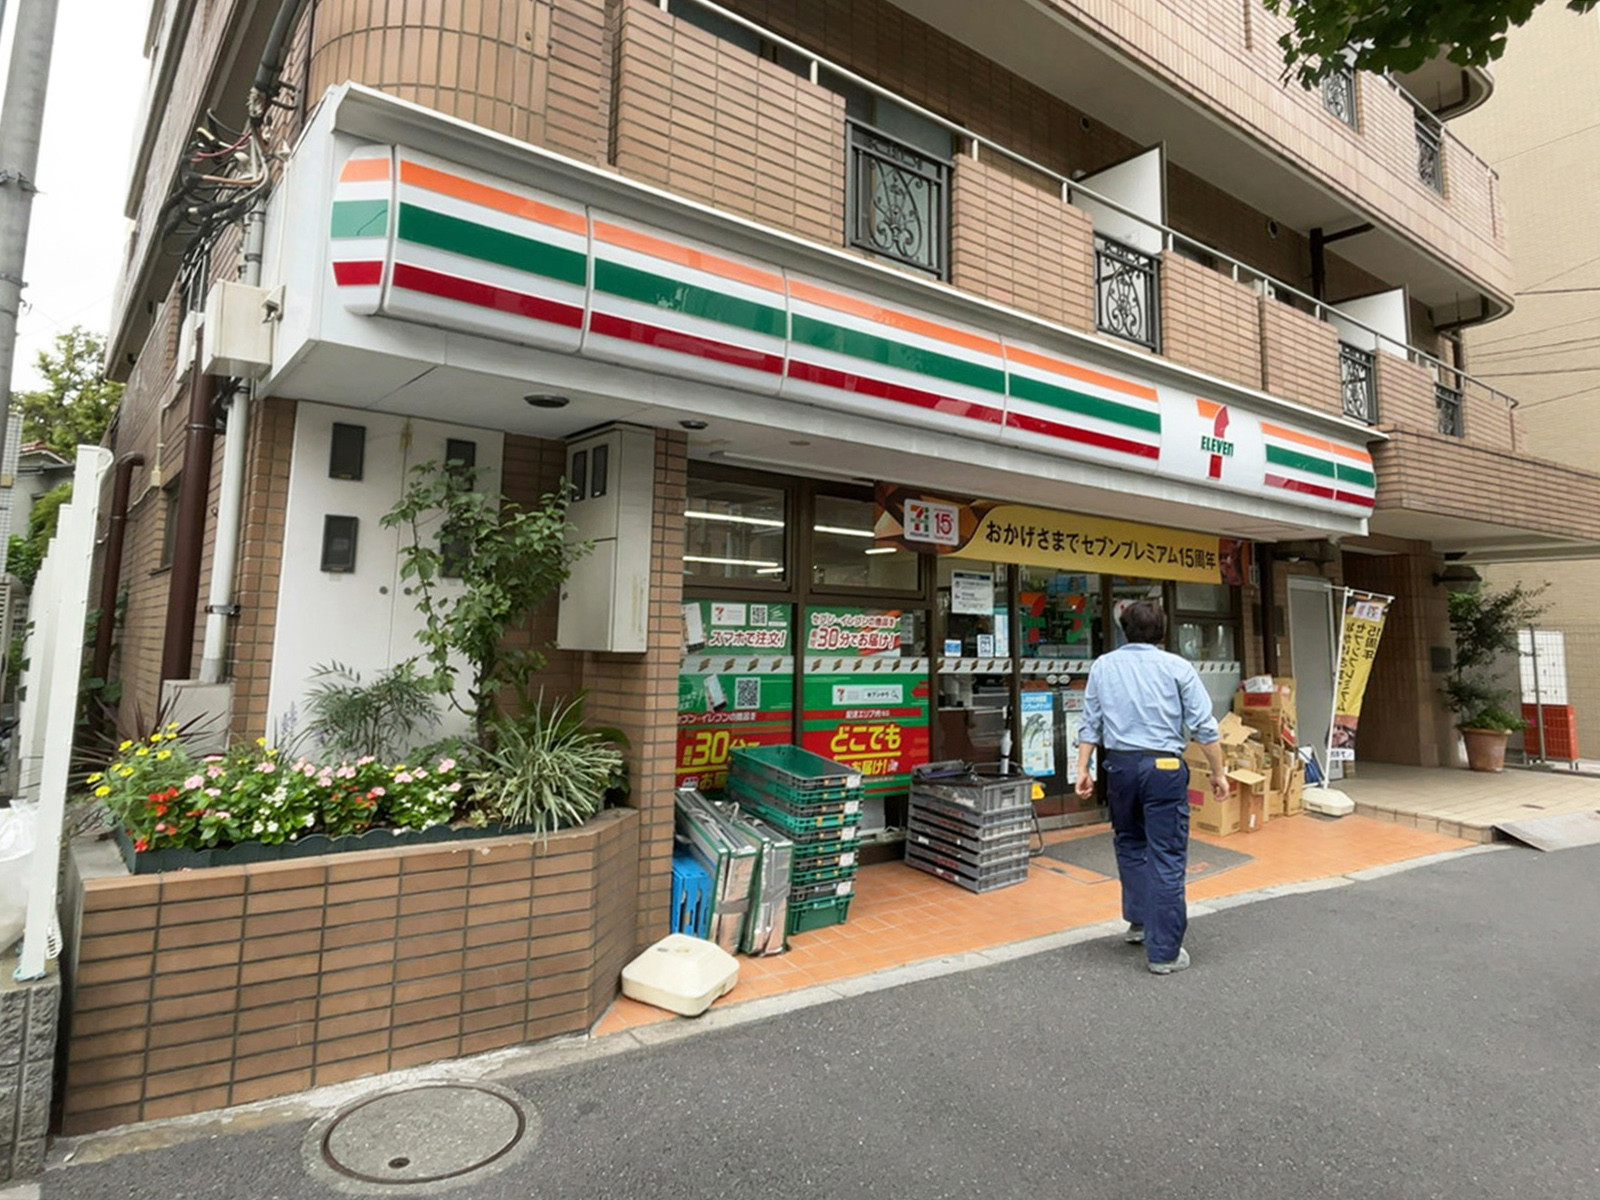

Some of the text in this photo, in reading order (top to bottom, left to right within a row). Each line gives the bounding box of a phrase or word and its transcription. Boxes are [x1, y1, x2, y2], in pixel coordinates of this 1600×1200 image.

[935, 512, 953, 535] 15
[985, 520, 1217, 571] おかげさまでセブンプレミアム15周年
[830, 724, 901, 753] どこでも
